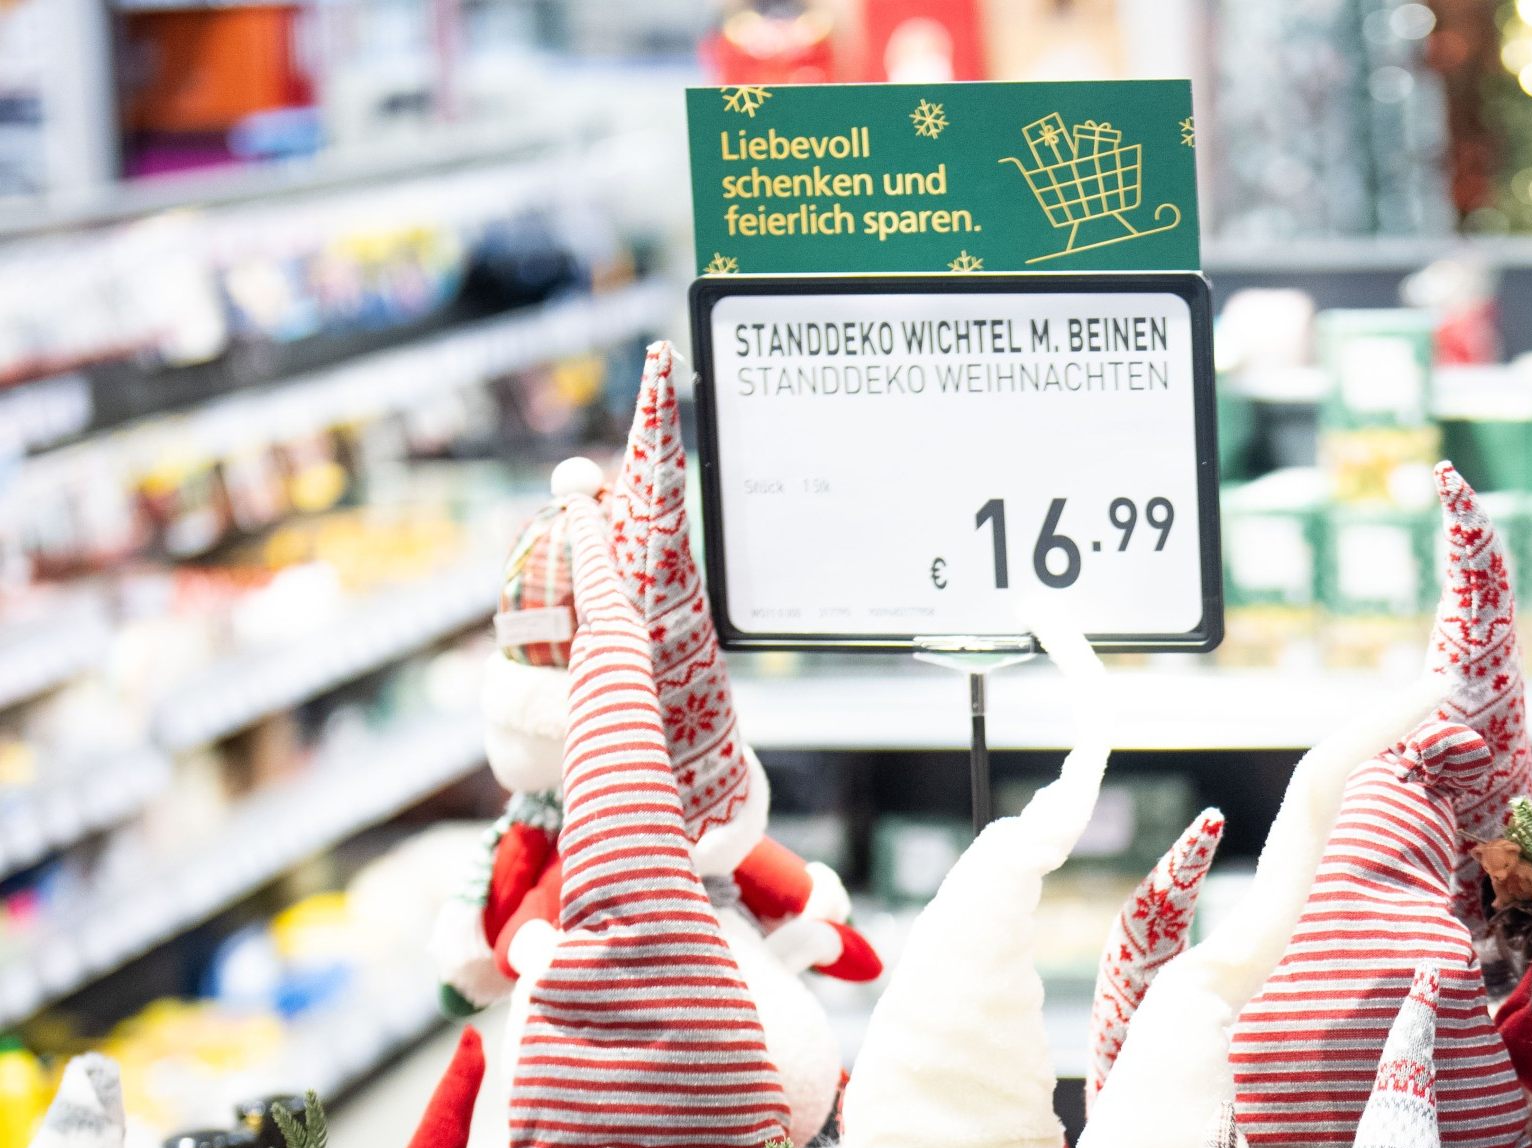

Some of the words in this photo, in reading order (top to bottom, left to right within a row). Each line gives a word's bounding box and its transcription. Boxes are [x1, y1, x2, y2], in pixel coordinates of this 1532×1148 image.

[720, 126, 870, 161] Liebevoll
[721, 166, 875, 199] schenken
[882, 163, 948, 196] und
[723, 202, 857, 238] feierlich
[863, 208, 983, 242] sparen.
[735, 321, 895, 358] STANDDEKO
[901, 319, 1022, 356] WICHTEL
[1029, 318, 1060, 354] M.
[1068, 316, 1168, 353] BEINEN
[737, 364, 927, 397] STANDDEKO
[935, 360, 1170, 394] WEIHNACHTEN
[930, 556, 949, 591] €
[975, 496, 1176, 591] 16.99
